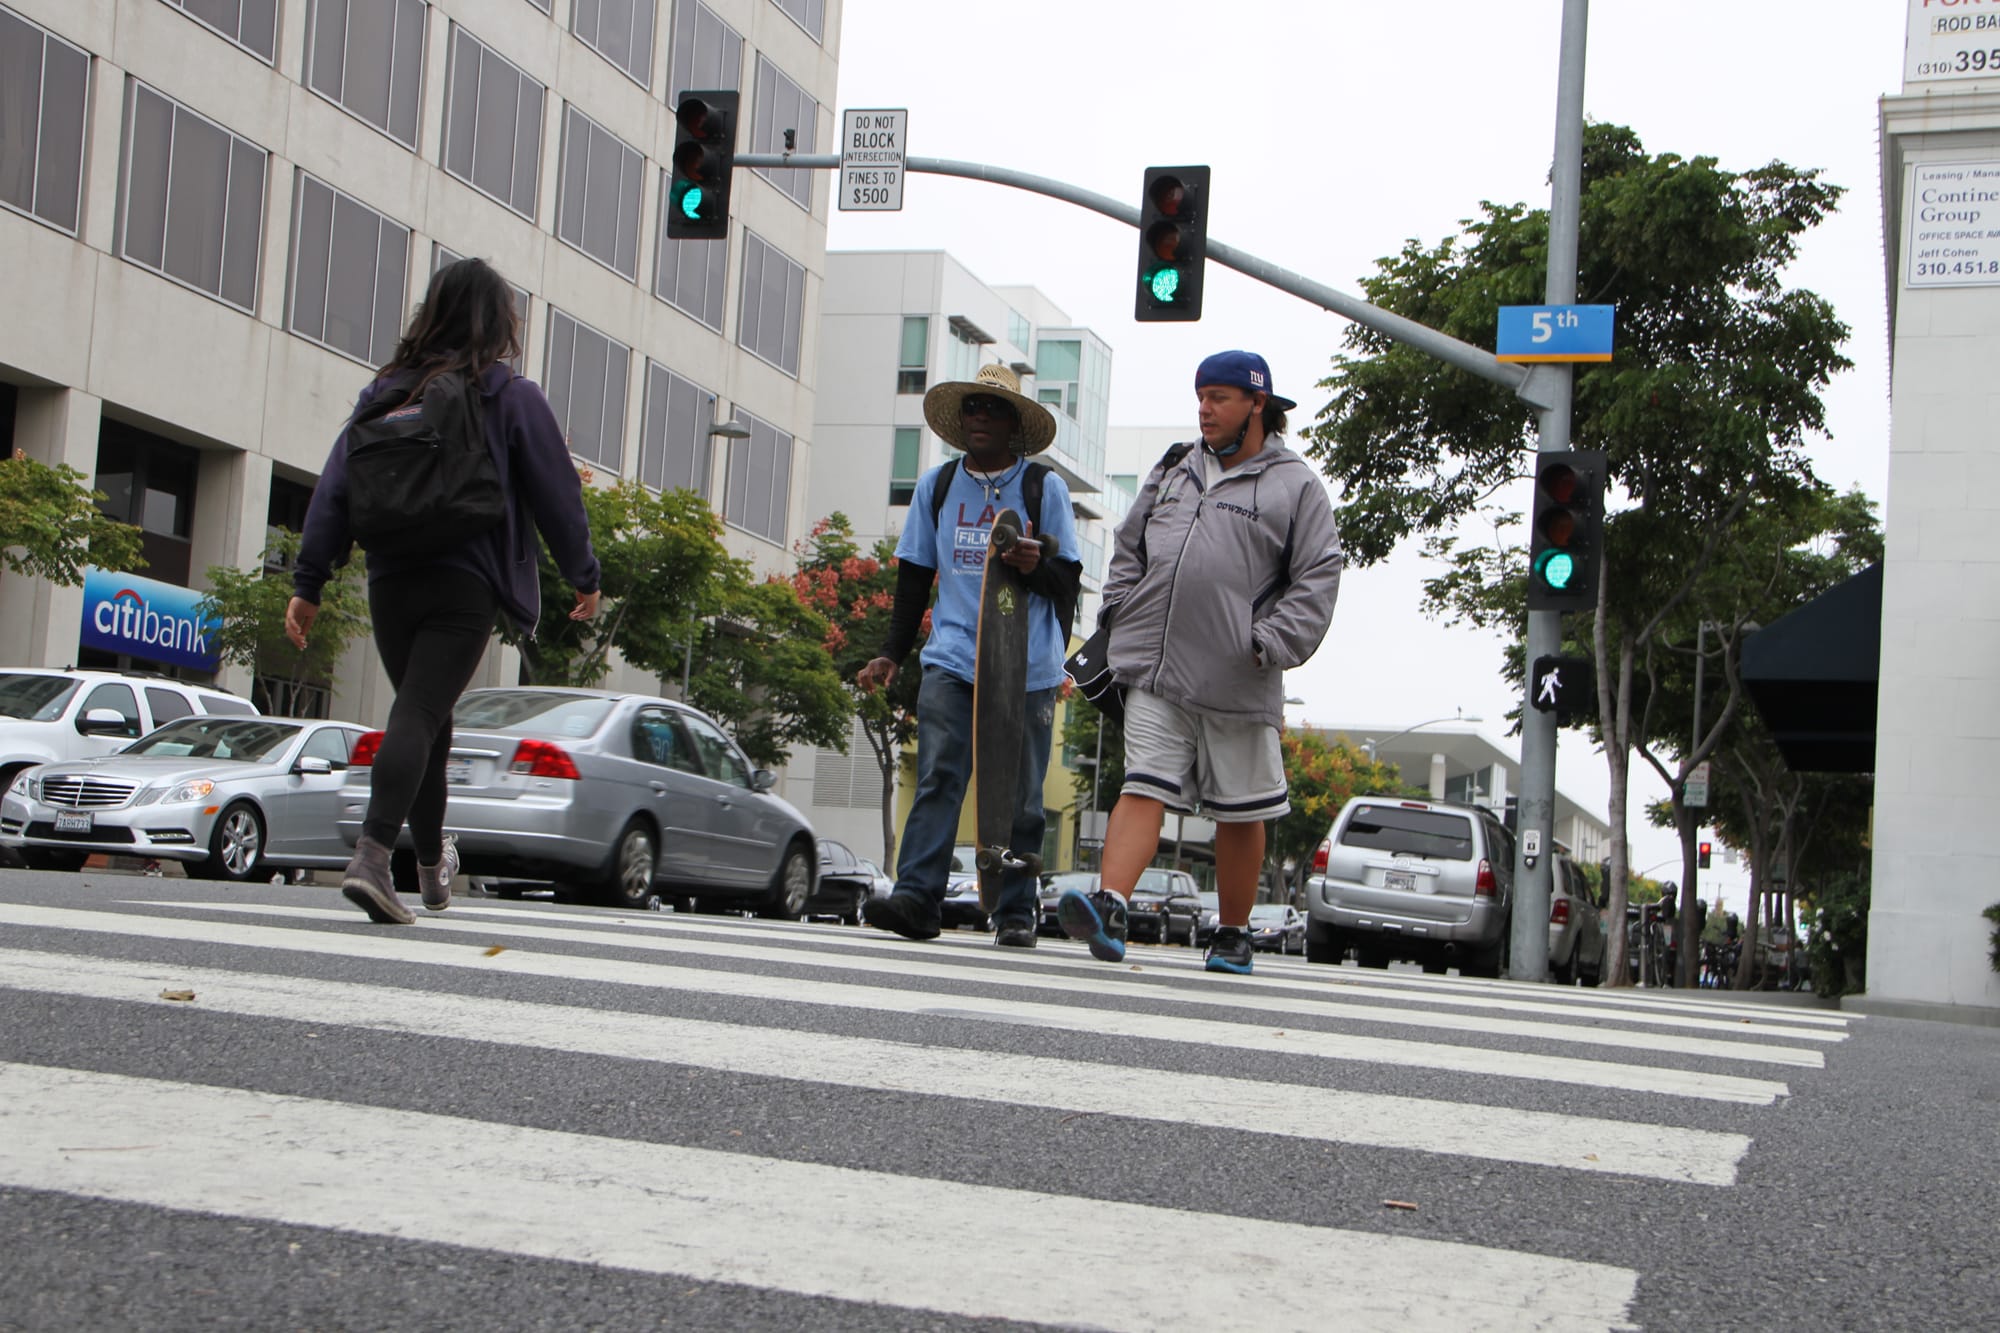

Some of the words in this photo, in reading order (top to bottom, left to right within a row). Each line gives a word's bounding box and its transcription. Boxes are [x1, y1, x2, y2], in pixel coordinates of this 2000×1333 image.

[1937, 17, 1971, 32] ROD
[1976, 14, 2000, 29] BA
[1918, 62, 1952, 75] (310)
[856, 116, 870, 129] DO
[875, 116, 895, 129] NOT
[853, 133, 895, 148] BLOCK
[845, 152, 902, 162] INTERSECTION
[848, 172, 878, 185] FINES
[884, 172, 896, 185] TO
[1922, 172, 1963, 181] Leasing
[853, 188, 889, 204] $500
[1922, 188, 2000, 204] Contine
[1921, 207, 1981, 224] Group
[1919, 231, 1952, 241] OFFICE
[1954, 230, 1983, 240] SPACE
[1918, 248, 1940, 258] Jeff
[1943, 248, 1979, 257] Cohen
[1917, 260, 1999, 276] 310.451.8
[1531, 310, 1578, 343] 5th
[957, 503, 995, 528] LA
[1216, 502, 1260, 522] COWBOYS
[954, 549, 987, 565] FES
[94, 598, 207, 654] citibank
